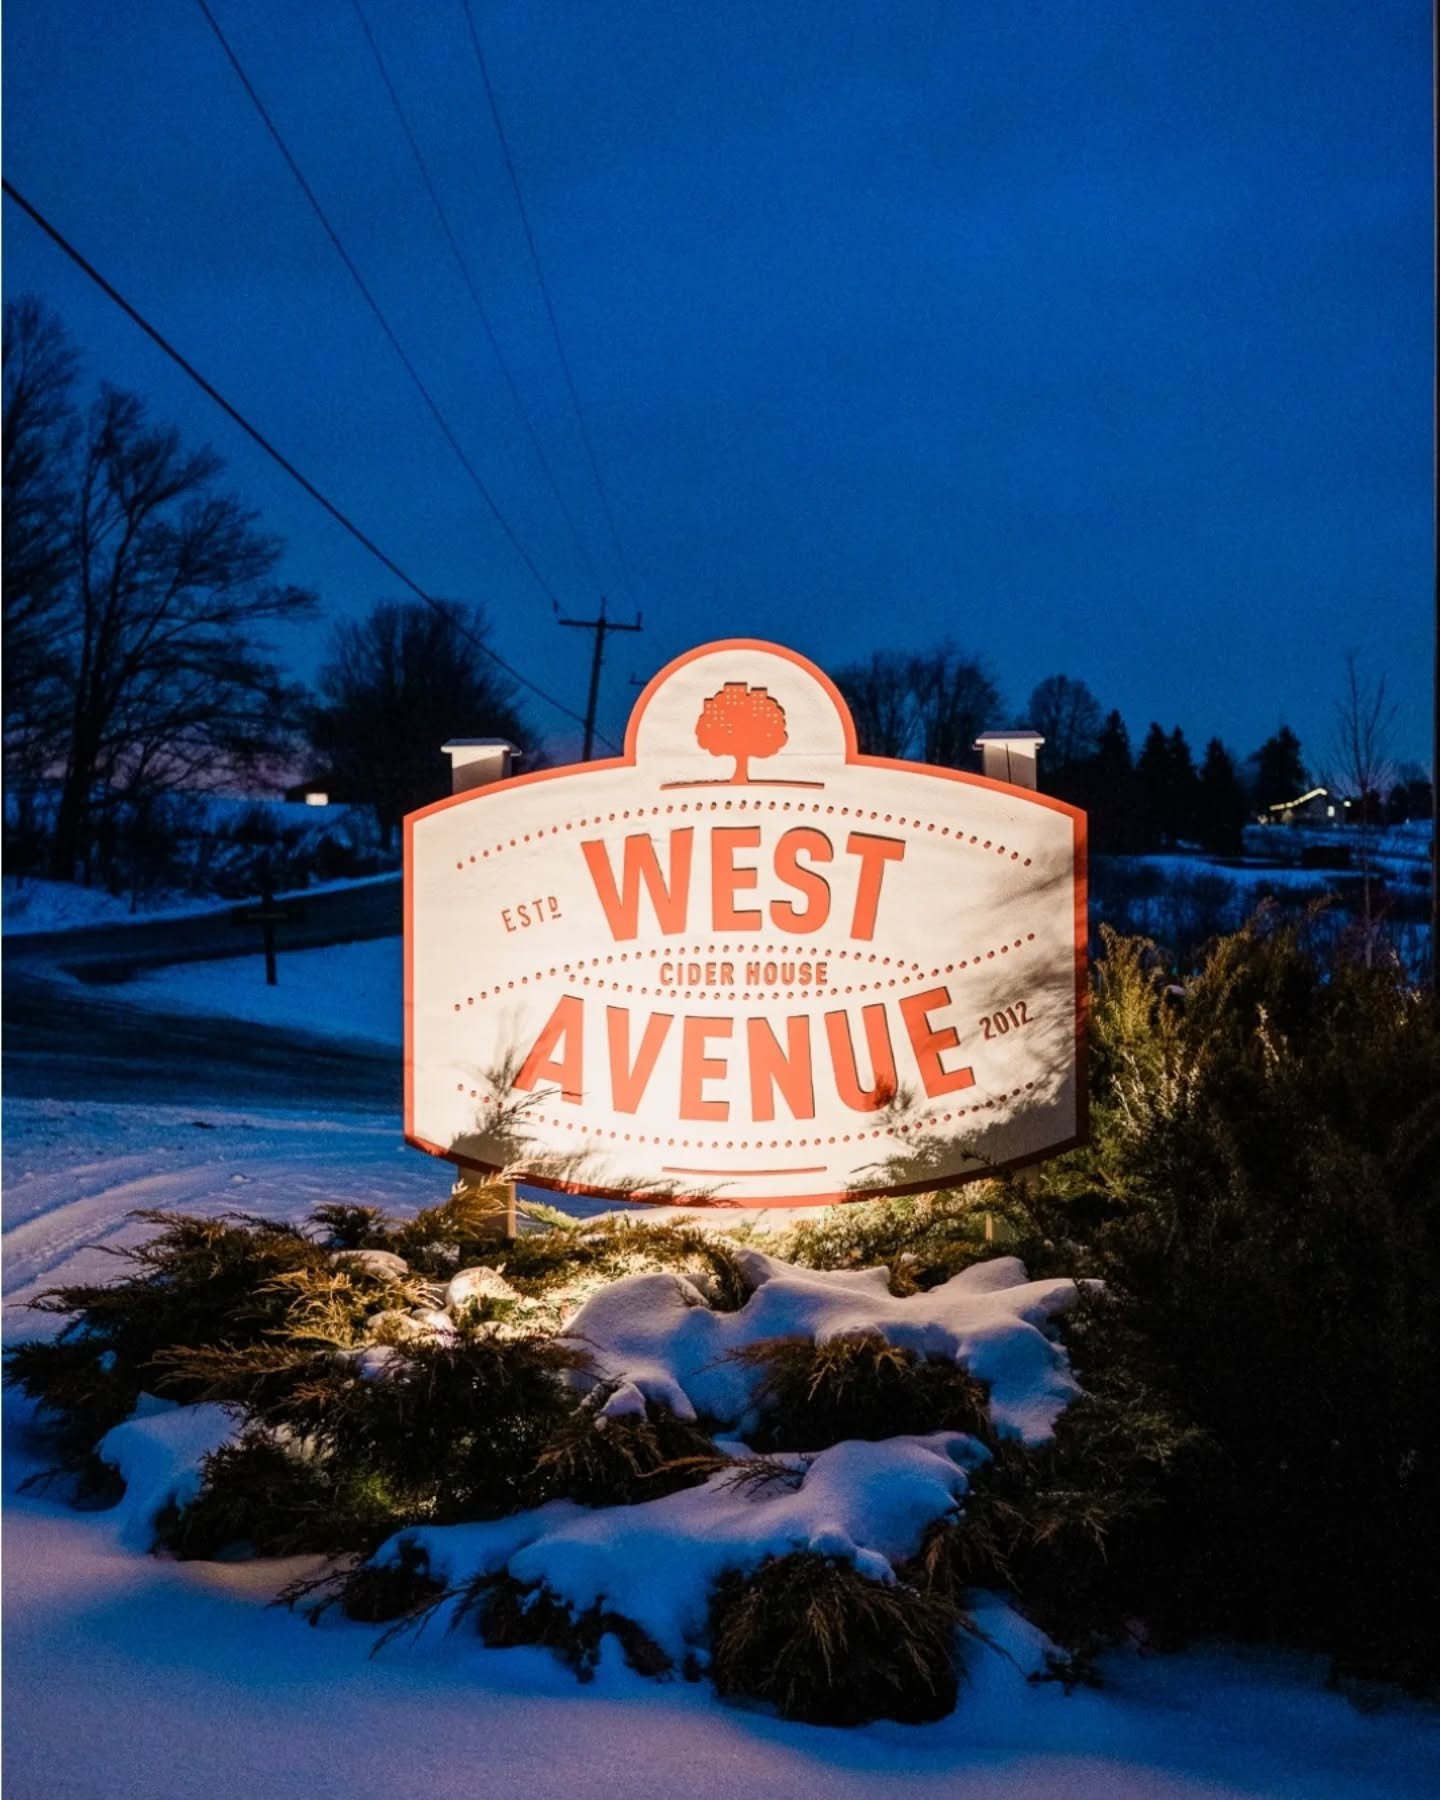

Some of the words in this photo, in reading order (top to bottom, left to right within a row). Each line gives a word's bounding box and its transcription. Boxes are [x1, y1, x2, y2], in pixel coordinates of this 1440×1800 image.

[581, 826, 906, 942] WEST
[501, 896, 562, 933] ESTD
[659, 962, 735, 986] CIDER
[745, 962, 828, 986] HOUSE
[979, 1001, 1034, 1040] 2012
[511, 986, 976, 1122] AVENUE
